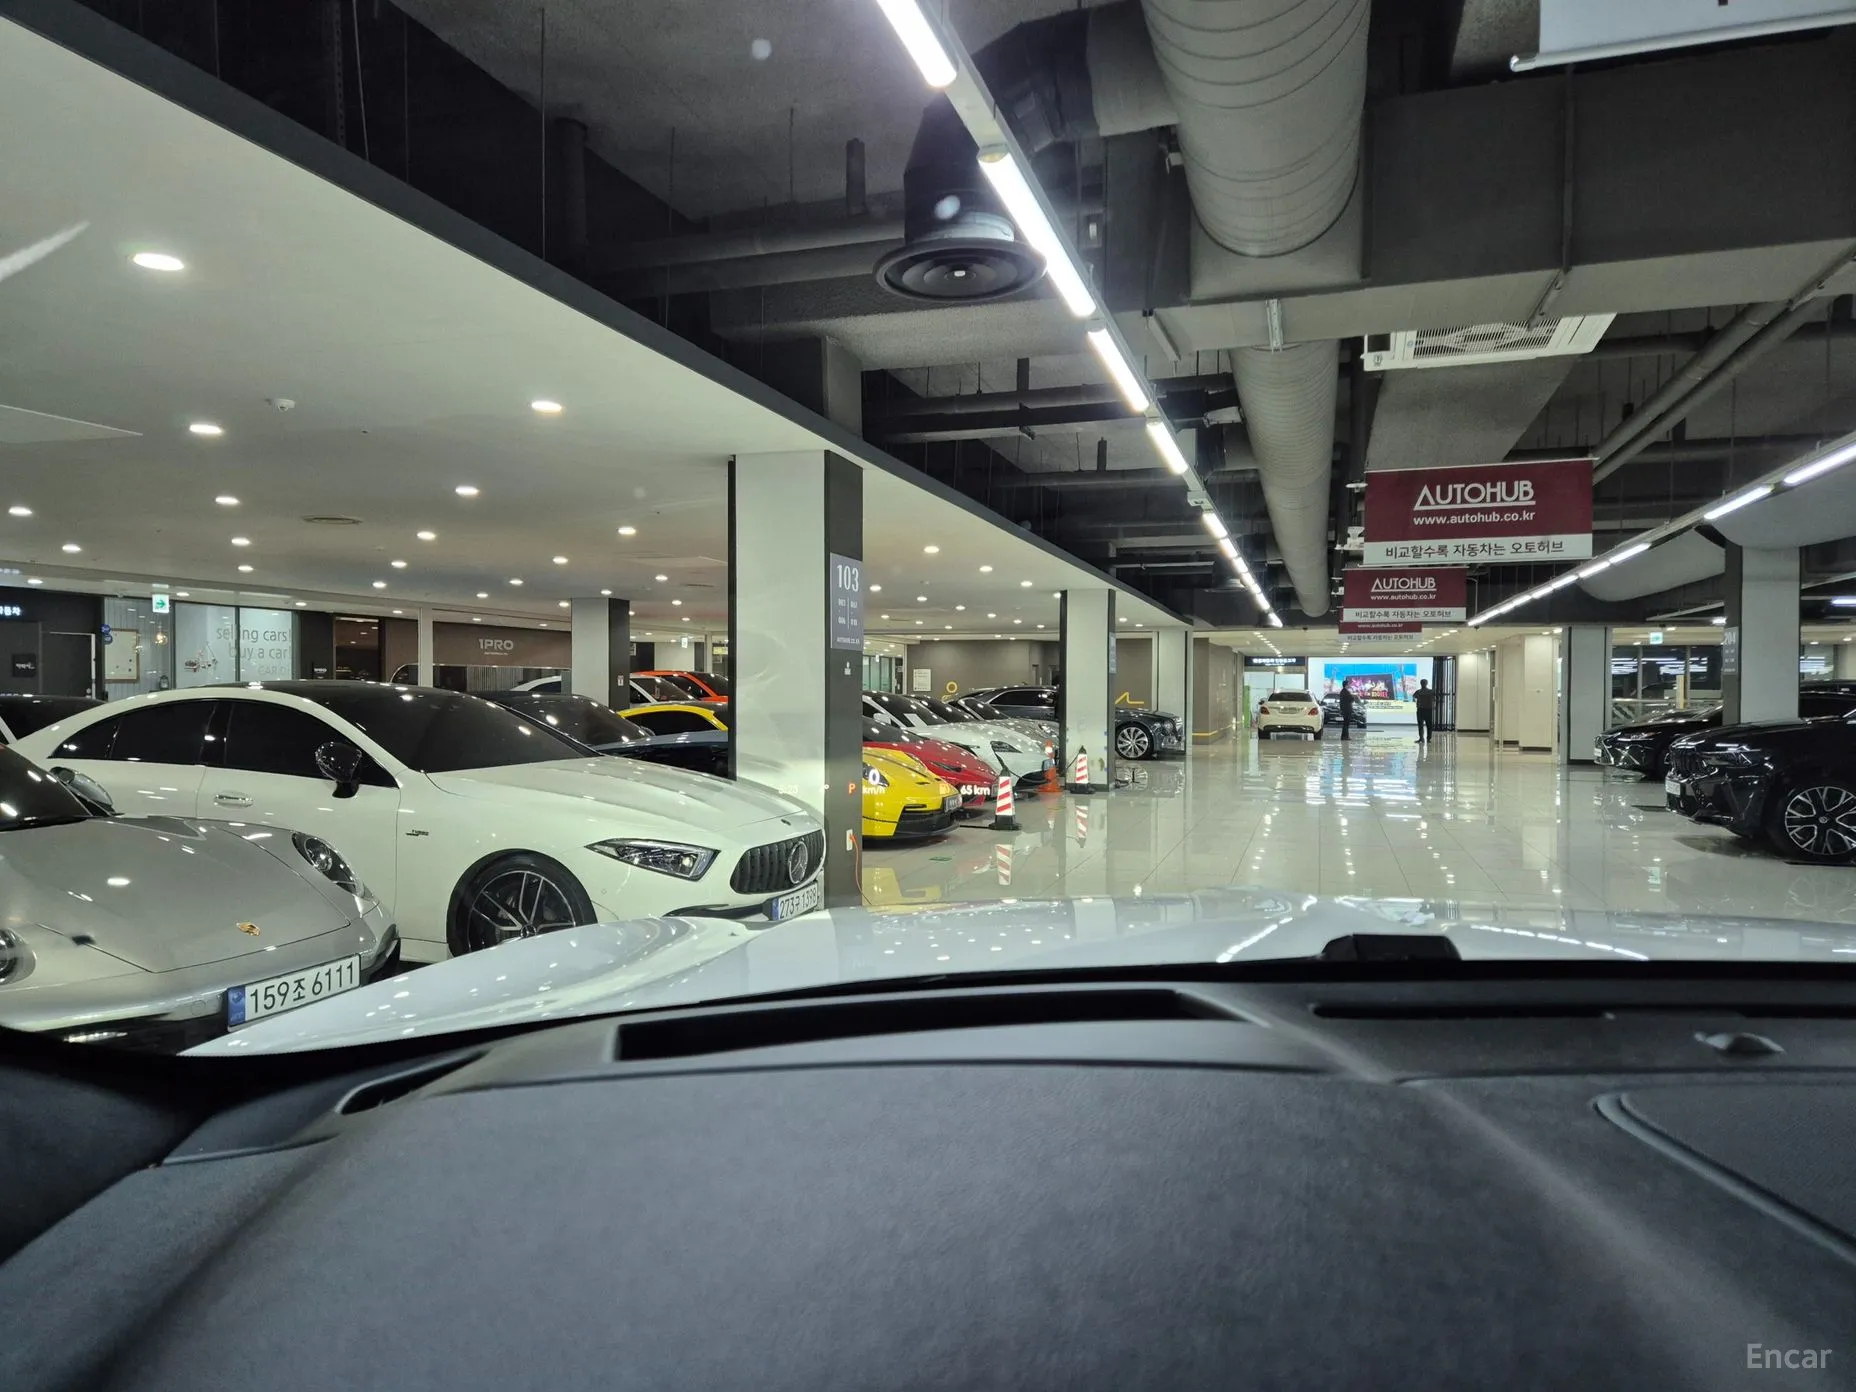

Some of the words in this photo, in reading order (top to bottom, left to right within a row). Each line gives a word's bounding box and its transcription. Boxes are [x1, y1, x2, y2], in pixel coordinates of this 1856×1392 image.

[1413, 480, 1536, 510] AUTOHUB
[1413, 510, 1536, 526] www.autohub.co.kr
[1385, 544, 1449, 560] 비교할수록
[1453, 541, 1506, 558] 자동차는
[1510, 540, 1565, 555] 오토허브
[837, 564, 860, 592] 103
[1371, 577, 1437, 592] AUTOHUB
[1370, 593, 1437, 601] www.autohub.co.kr
[1355, 610, 1390, 618] 비교할수록
[1392, 610, 1420, 618] 자동차는
[1422, 610, 1452, 618] 오토허브
[478, 638, 514, 651] 1PRO
[848, 783, 856, 795] P
[960, 785, 972, 796] 65
[973, 784, 991, 796] km
[249, 977, 306, 1014] 159조
[311, 961, 354, 996] 6111
